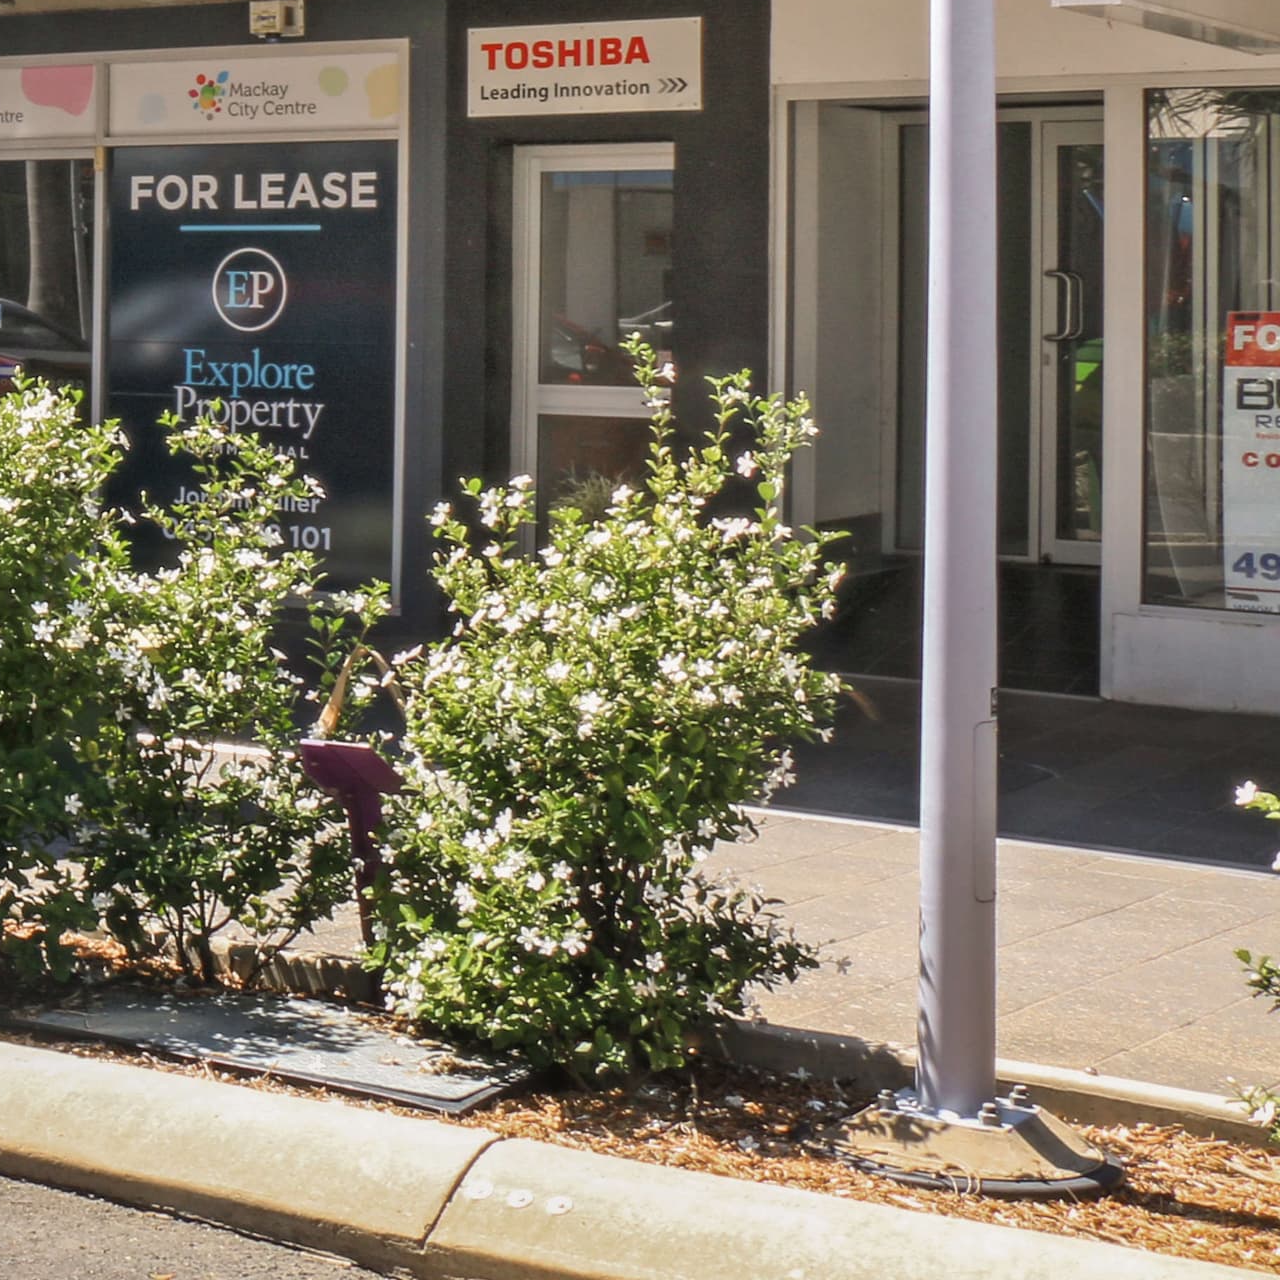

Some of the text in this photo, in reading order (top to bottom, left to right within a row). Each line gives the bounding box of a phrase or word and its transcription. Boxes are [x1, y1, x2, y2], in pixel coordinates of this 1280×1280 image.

[481, 36, 650, 70] TOSHIBA
[228, 81, 289, 102] Mackay
[481, 79, 650, 102] Leading Innovation
[228, 98, 317, 121] City Centre
[130, 170, 378, 211] FOR LEASE
[225, 270, 274, 310] EP
[182, 348, 315, 398] Explore
[173, 385, 325, 440] Property
